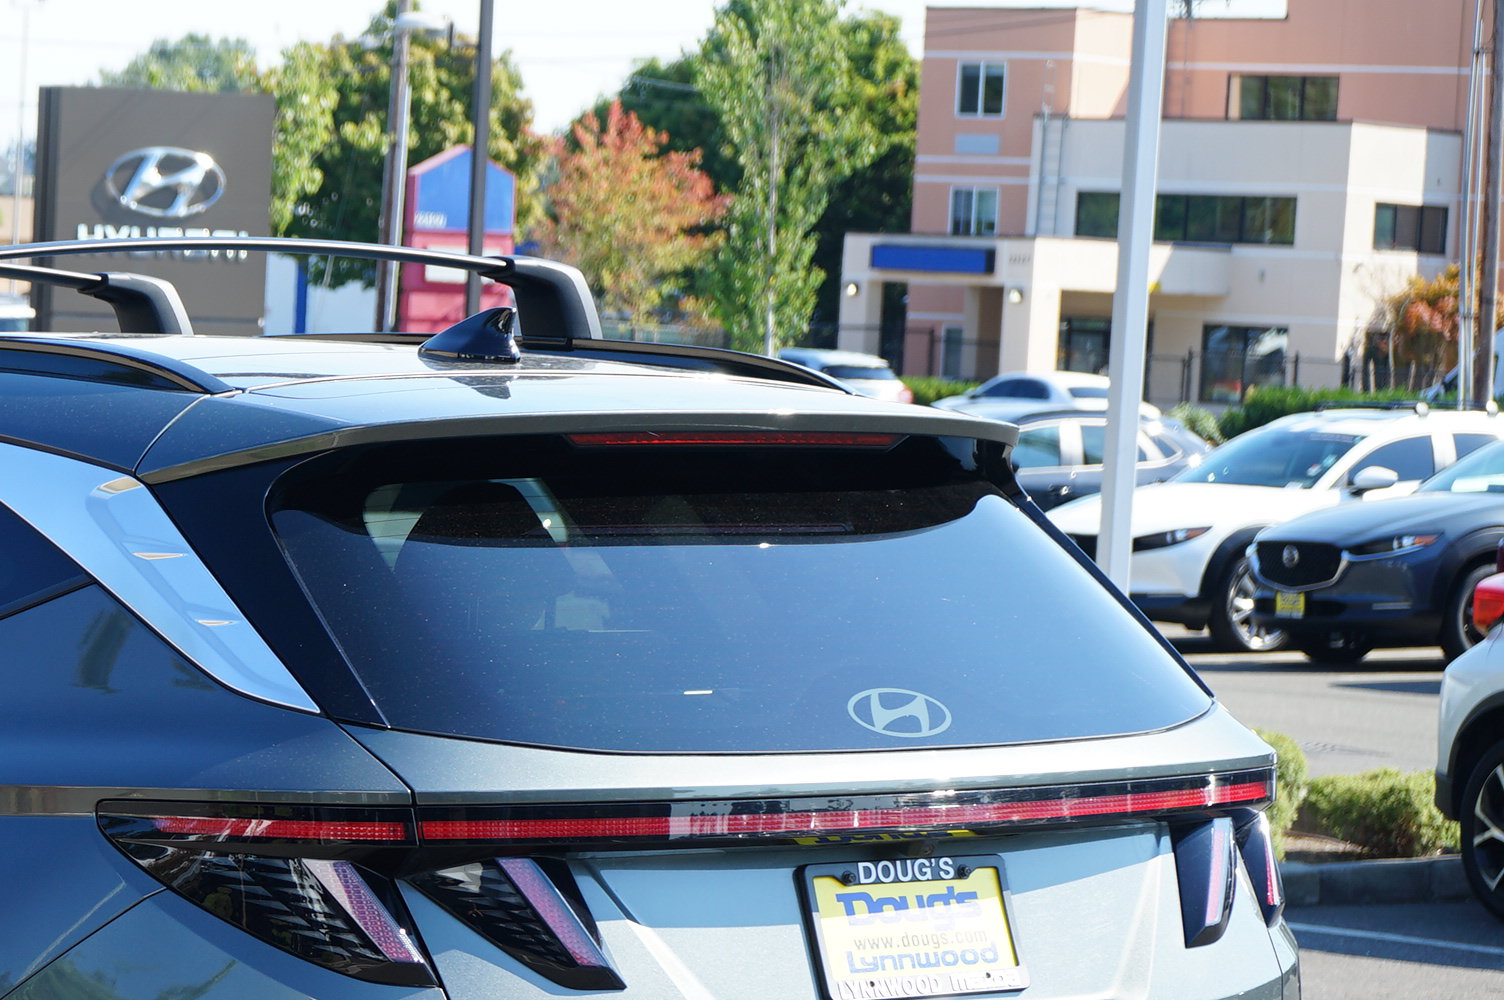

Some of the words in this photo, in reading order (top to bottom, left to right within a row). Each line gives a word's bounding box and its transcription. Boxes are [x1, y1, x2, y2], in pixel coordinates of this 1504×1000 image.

[857, 857, 955, 885] DOUG'S
[853, 930, 988, 951] www.dougs.com
[846, 941, 999, 974] Lynnwood
